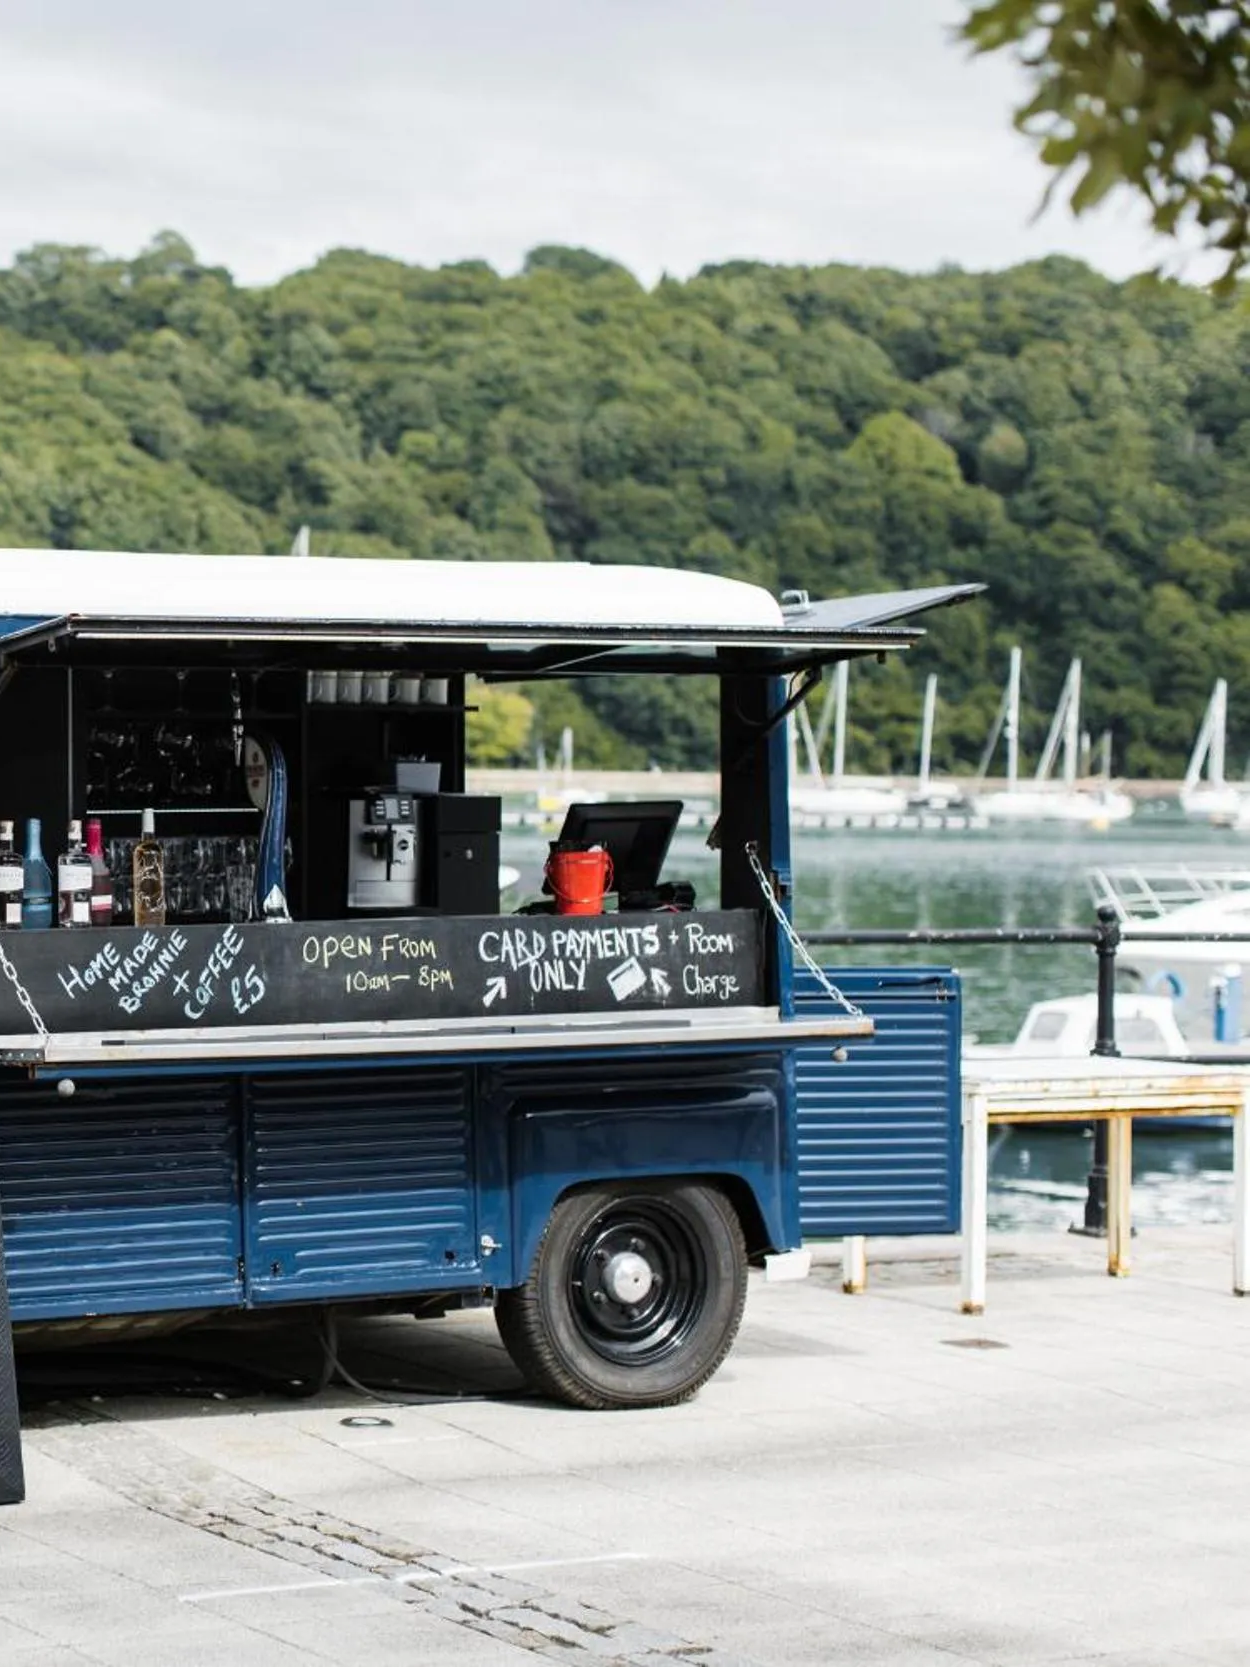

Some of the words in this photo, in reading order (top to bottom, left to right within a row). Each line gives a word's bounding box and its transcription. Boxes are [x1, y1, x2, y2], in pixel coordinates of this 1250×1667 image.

[108, 930, 160, 992] MADE
[118, 928, 189, 1015] BROWNIE
[184, 924, 245, 1020] COFFEE
[478, 929, 546, 970] CARD
[552, 924, 660, 963] PAYMENTS
[530, 958, 586, 992] ONLY
[682, 964, 740, 1000] Charge
